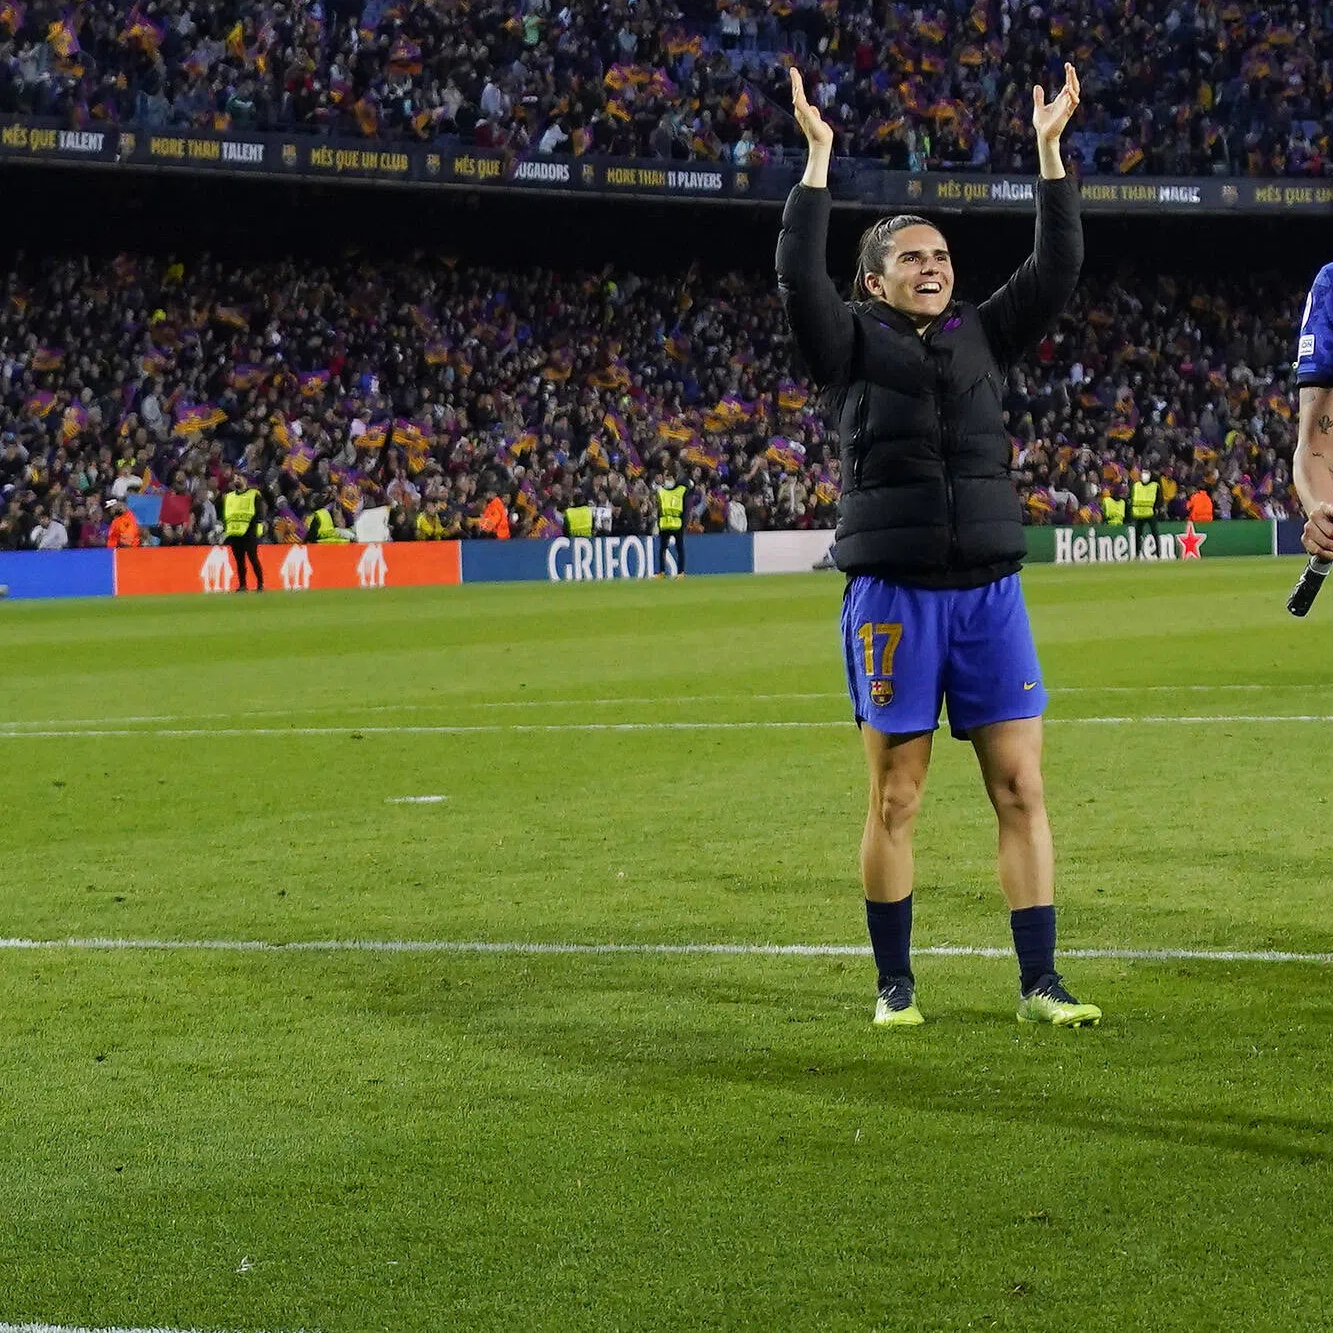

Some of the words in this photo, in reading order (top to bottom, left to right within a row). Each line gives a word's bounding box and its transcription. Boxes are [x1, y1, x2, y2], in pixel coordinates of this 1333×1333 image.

[1, 123, 28, 146] MÉS
[30, 128, 57, 154] QUE
[59, 130, 105, 152] TALENT
[151, 138, 186, 156] MORE
[188, 140, 220, 158] THAN
[222, 142, 264, 161] TALENT
[311, 146, 333, 167] MÉS
[336, 149, 359, 171] QUE
[360, 152, 378, 169] UN
[380, 152, 408, 171] CLUB
[454, 154, 476, 174] MÉS
[478, 158, 501, 178] QUE
[607, 168, 637, 186] MORE
[639, 169, 666, 187] THAN
[677, 171, 723, 190] PLAYERS
[937, 179, 962, 199] MÉS
[965, 183, 989, 202] QUE
[1159, 186, 1201, 204] MAGIC
[858, 622, 903, 677] 17
